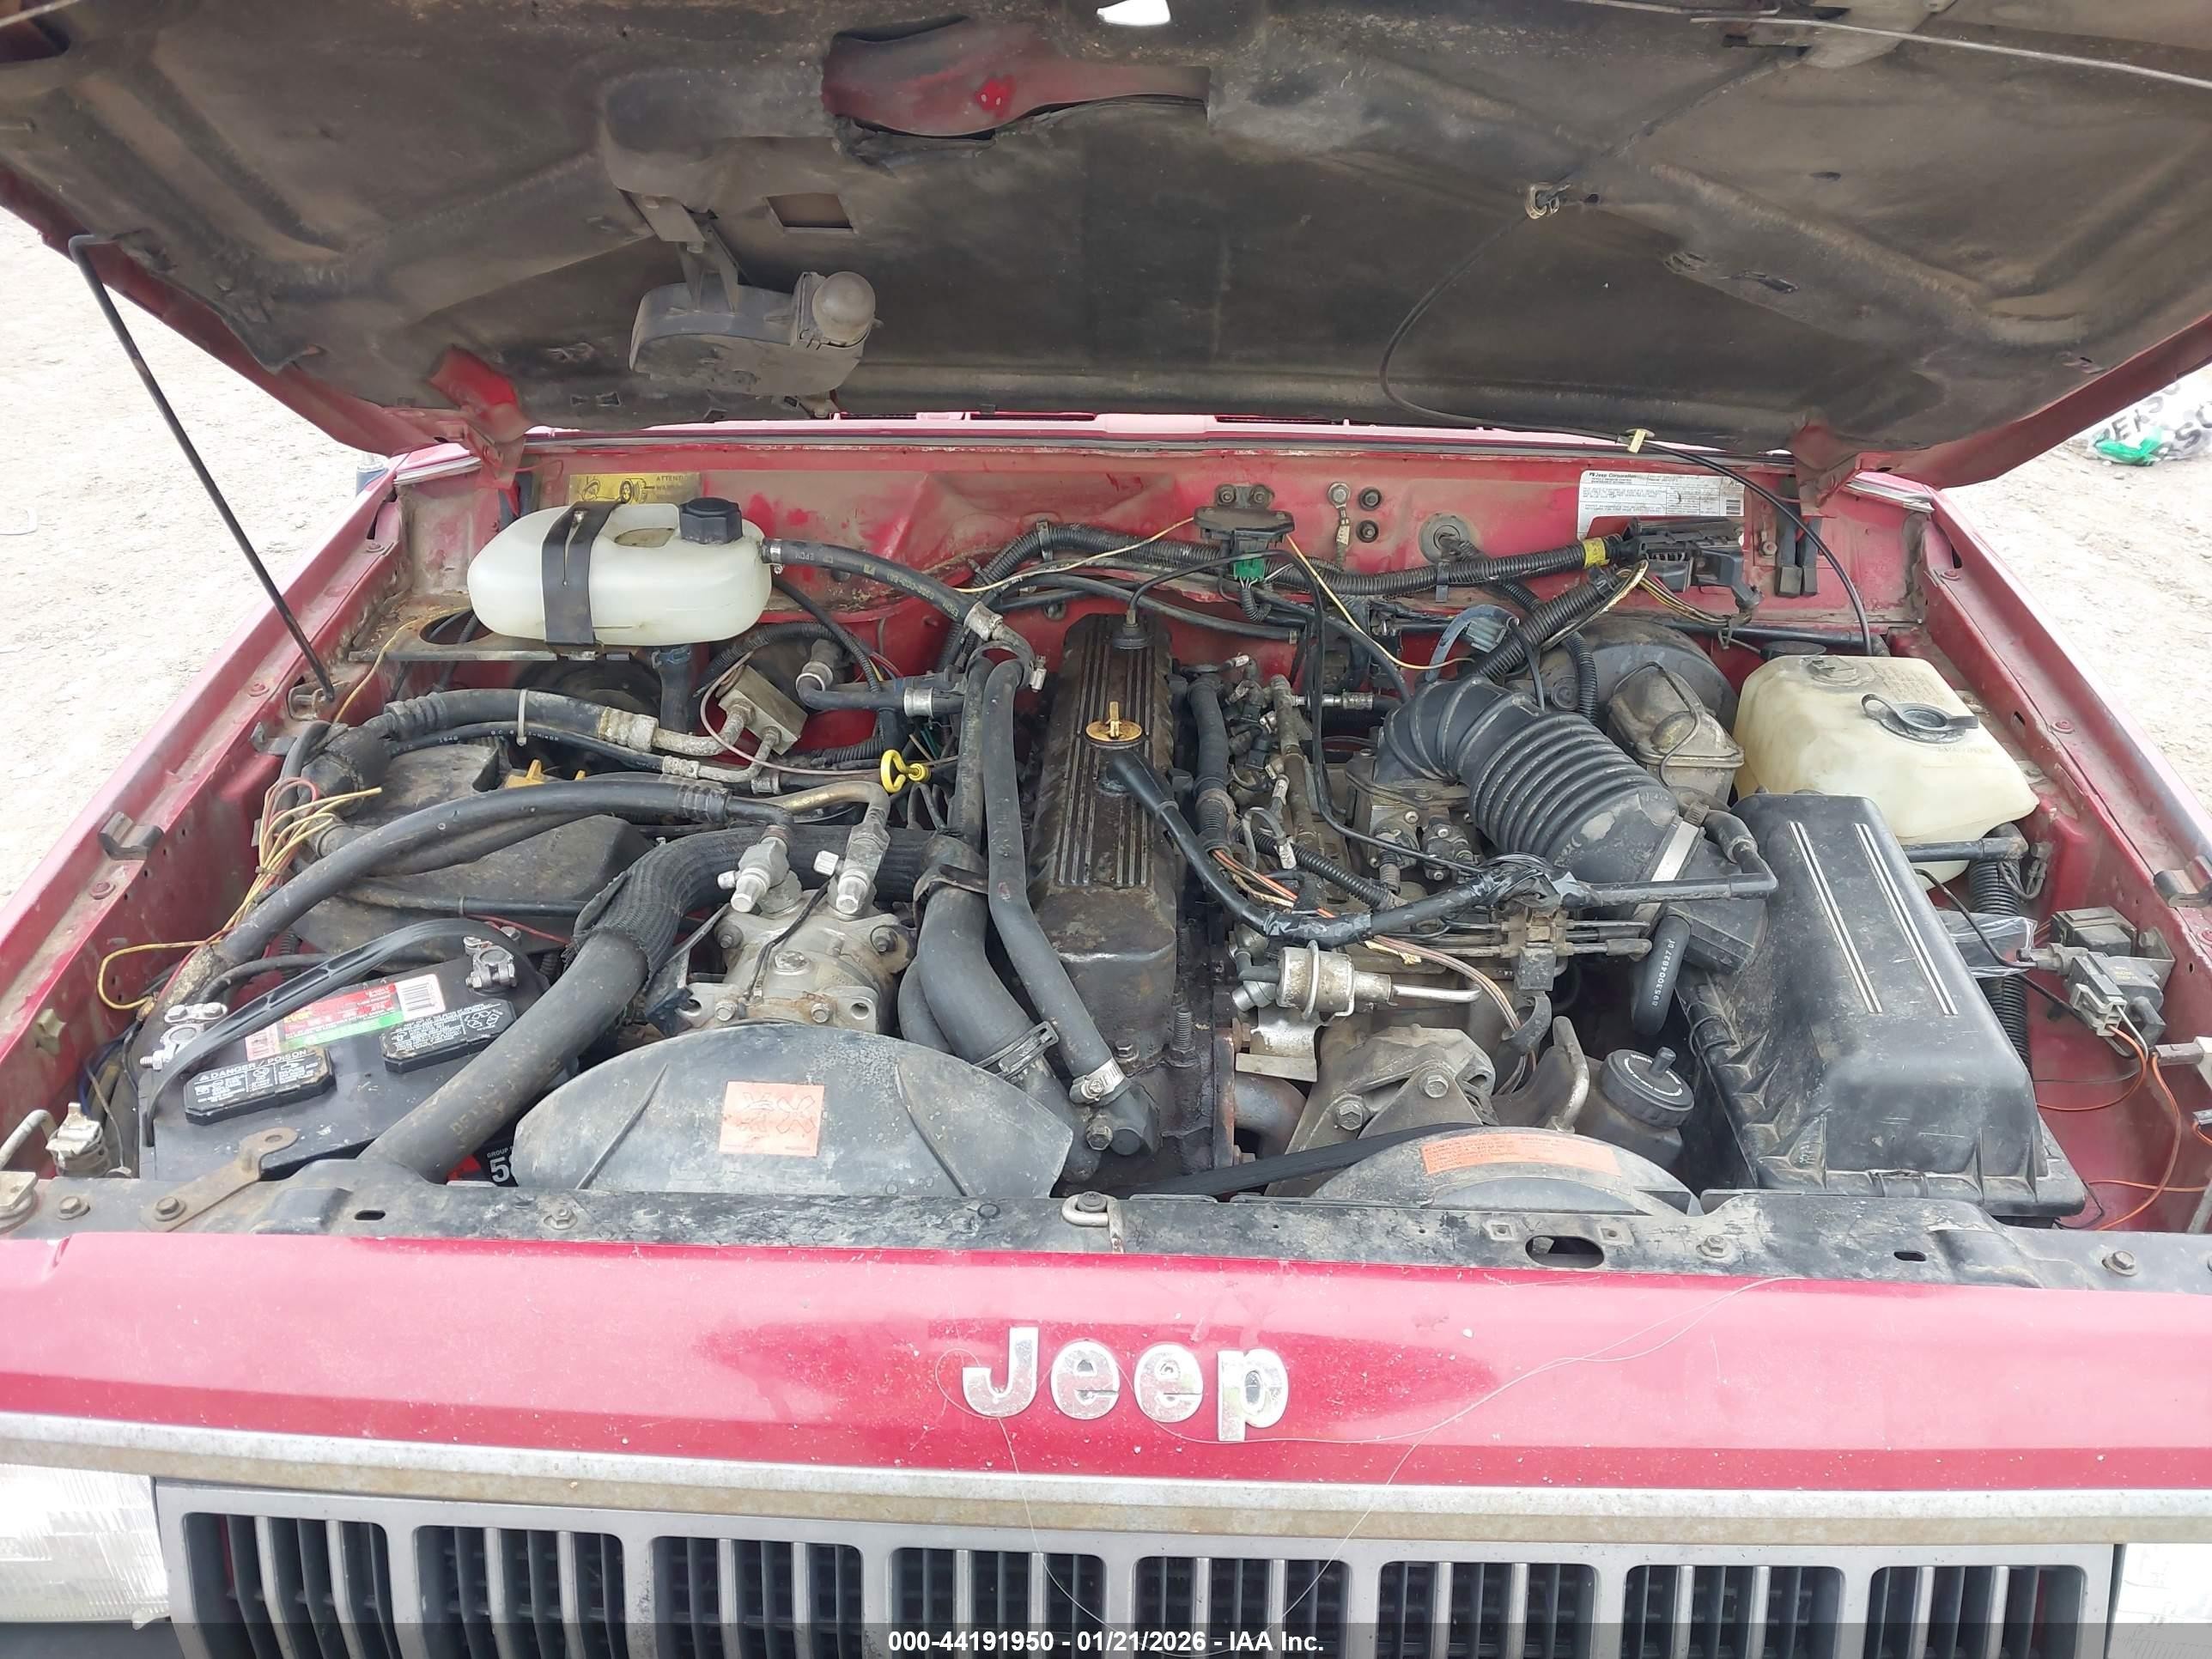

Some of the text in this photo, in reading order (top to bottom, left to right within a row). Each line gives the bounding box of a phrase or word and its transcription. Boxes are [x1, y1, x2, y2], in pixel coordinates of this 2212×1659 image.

[210, 1062, 256, 1079] DANGER
[267, 1049, 307, 1065] POISON
[486, 1147, 508, 1158] GROUP
[962, 1326, 1289, 1443] Jeep
